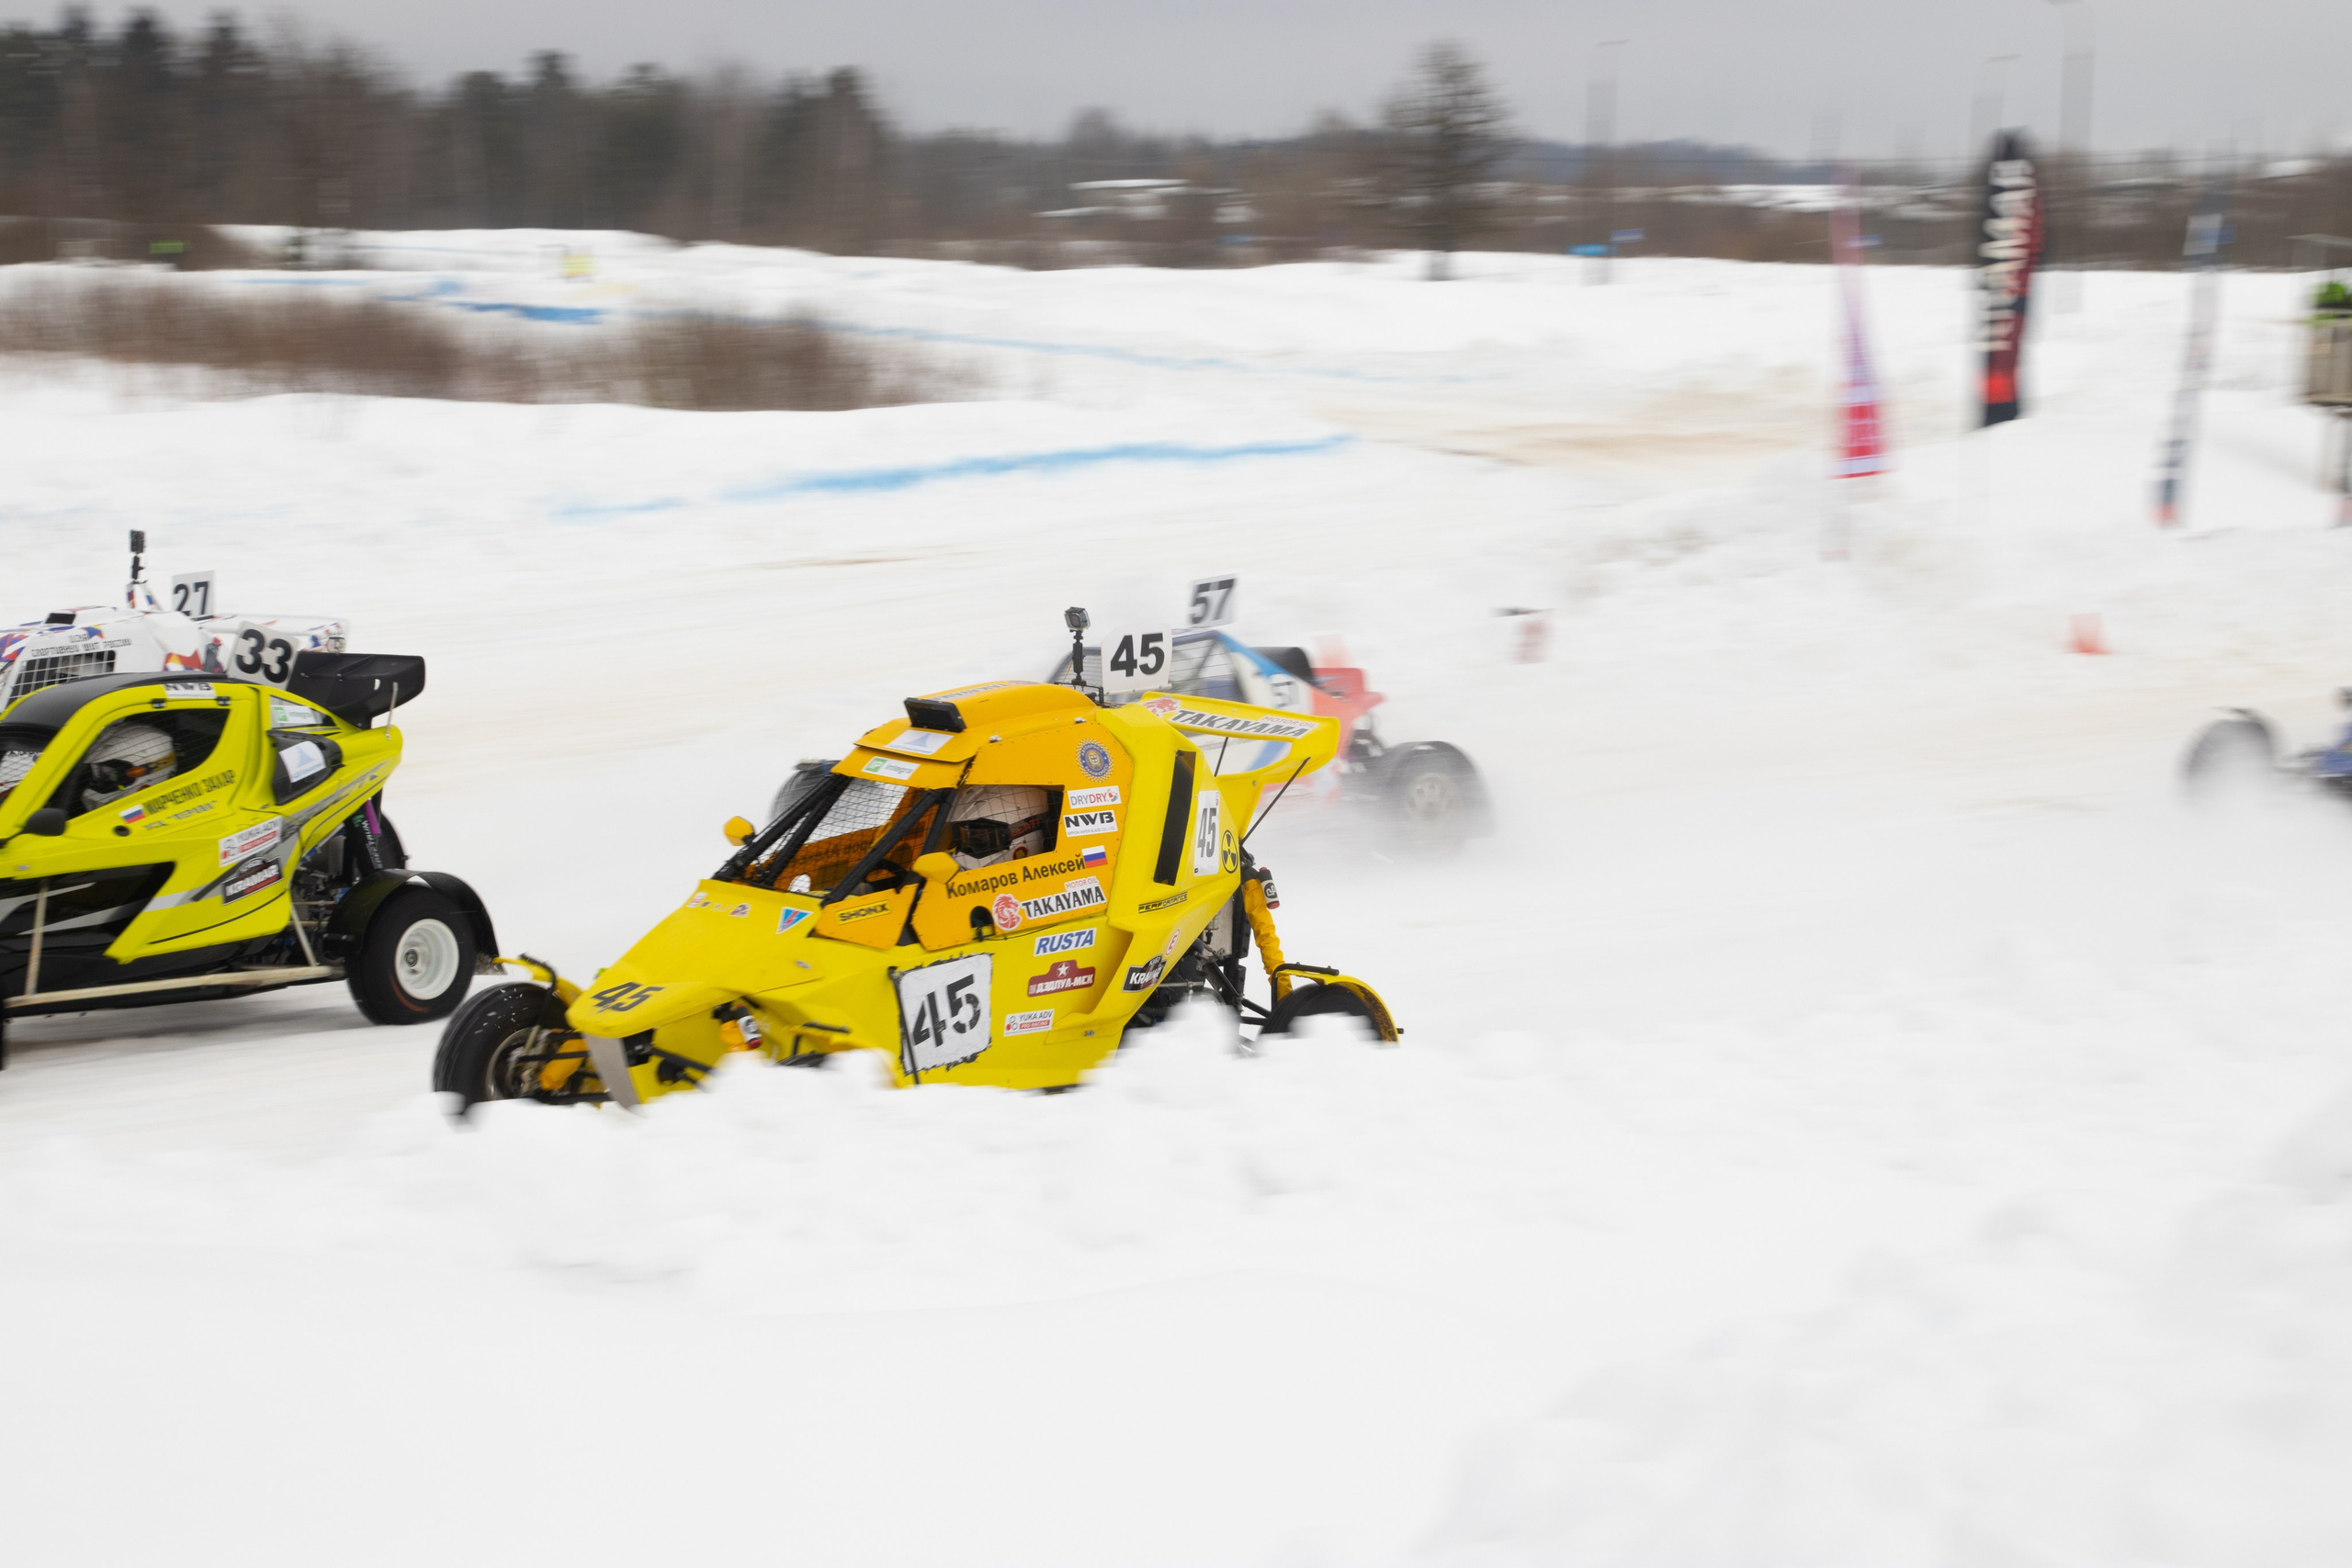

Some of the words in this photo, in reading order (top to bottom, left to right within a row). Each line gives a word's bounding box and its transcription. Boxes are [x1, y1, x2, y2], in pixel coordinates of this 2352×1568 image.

[173, 581, 209, 616] 27
[1191, 579, 1235, 624] 57
[236, 628, 292, 683] 33
[1110, 632, 1165, 677] 45
[1170, 710, 1310, 737] TAKAYAMA
[1263, 716, 1298, 726] MOTOR
[1070, 793, 1108, 807] DRYDRY
[1011, 818, 1041, 837] LEATT
[1065, 811, 1114, 828] NWB
[1197, 807, 1217, 858] 45
[946, 873, 1017, 898] Комаров
[1023, 854, 1085, 882] Алексей
[1066, 879, 1087, 889] MOTOR
[1087, 877, 1098, 886] OIL
[839, 903, 889, 921] SHONX
[1022, 886, 1105, 918] TAKAYAMA
[1035, 930, 1094, 954] RUSTA
[591, 982, 667, 1012] 45
[912, 974, 980, 1047] 45
[1019, 1011, 1038, 1022] YUKA
[1039, 1010, 1054, 1019] ADV
